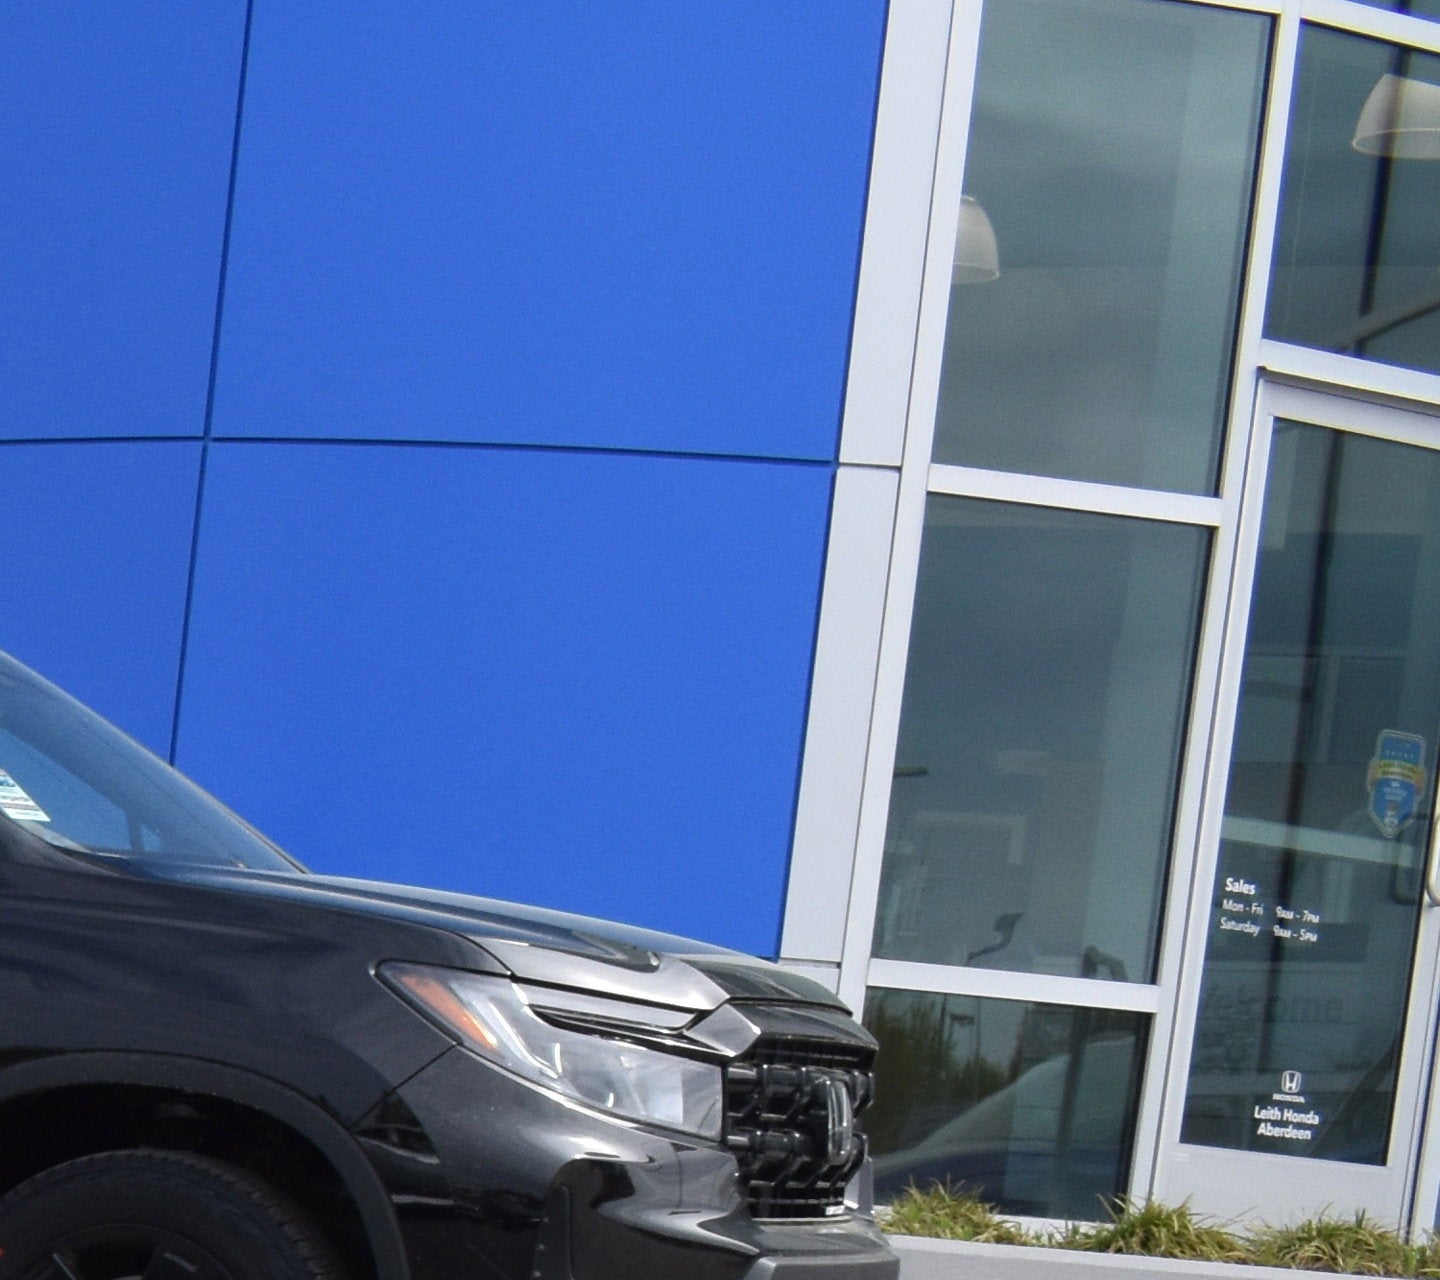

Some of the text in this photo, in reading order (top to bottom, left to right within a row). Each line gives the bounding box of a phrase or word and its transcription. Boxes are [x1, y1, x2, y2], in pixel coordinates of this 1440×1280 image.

[1225, 877, 1256, 895] Sales
[1222, 899, 1244, 912] Mon
[1251, 902, 1264, 915] Fri
[1220, 916, 1261, 937] Saturday
[1254, 1105, 1320, 1125] Leith Honda
[1257, 1122, 1312, 1140] Aberdeen
